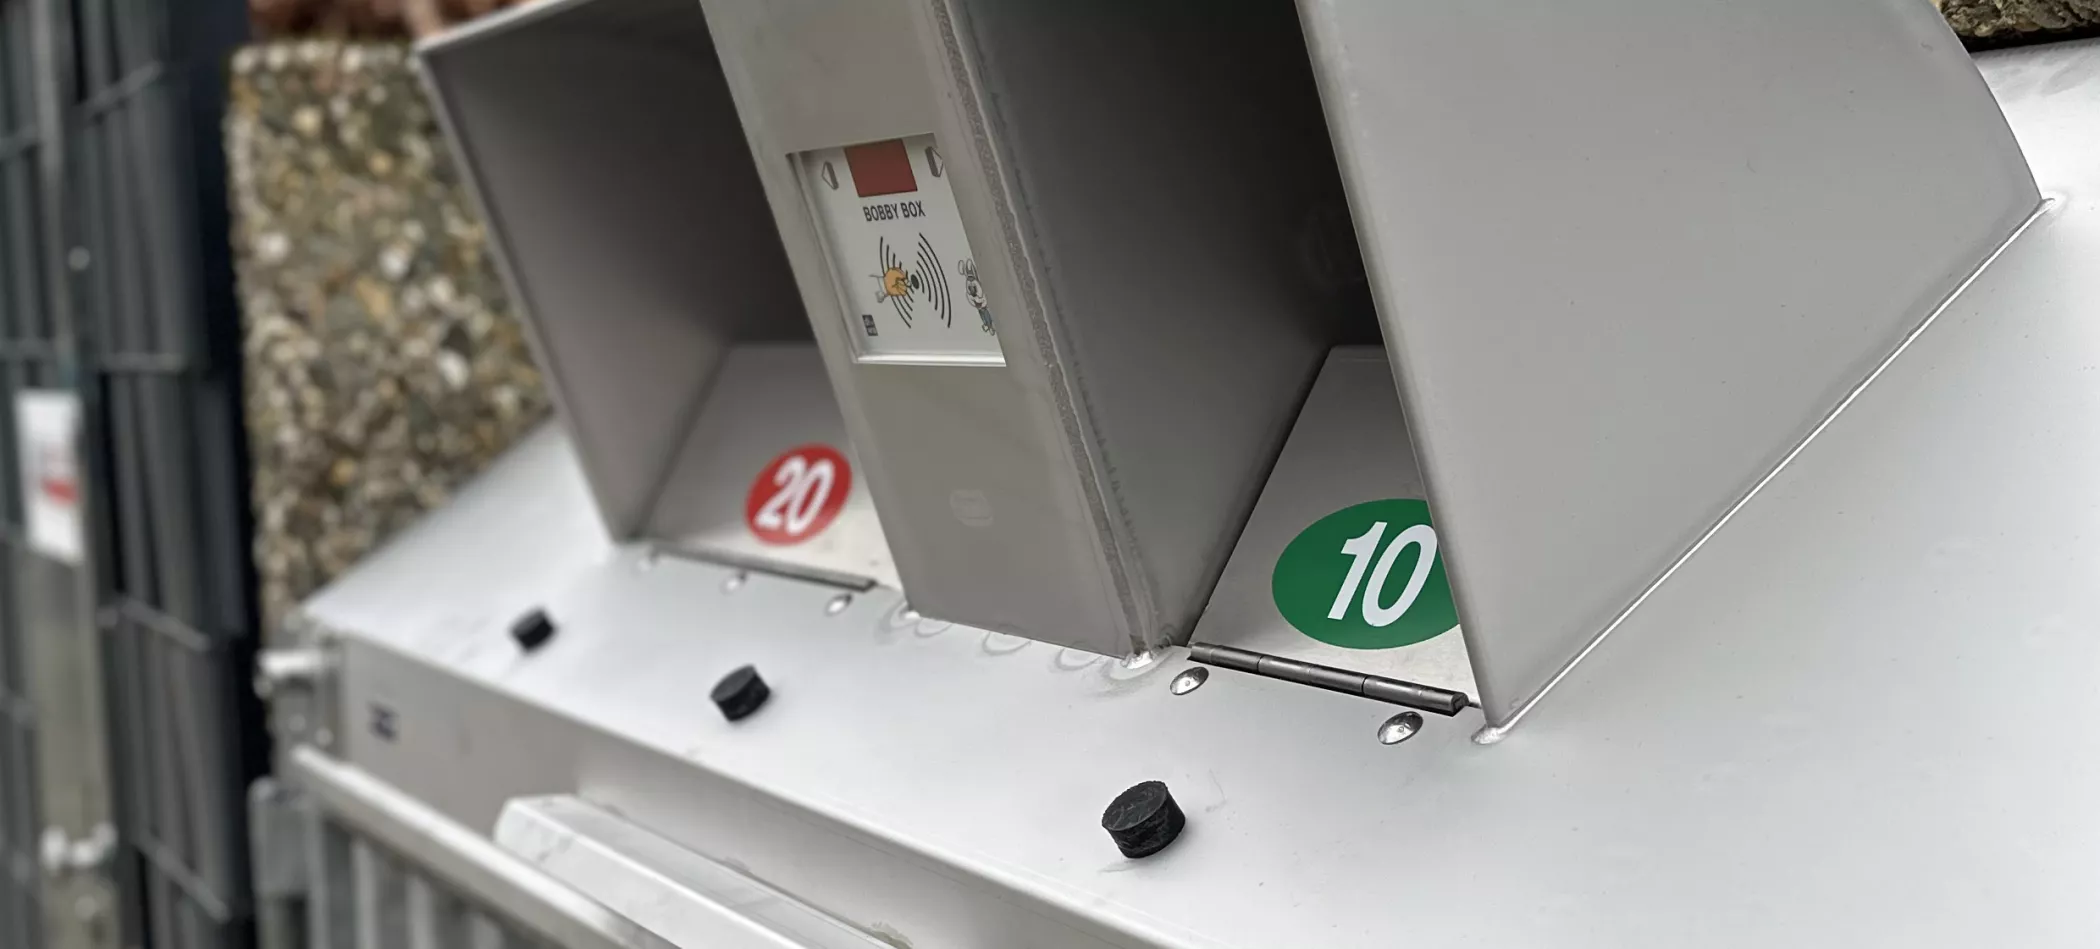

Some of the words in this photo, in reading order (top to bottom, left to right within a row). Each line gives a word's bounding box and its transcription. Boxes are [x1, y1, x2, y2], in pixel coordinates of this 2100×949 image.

[863, 204, 898, 221] BOBBY
[900, 201, 926, 218] BOX
[755, 455, 835, 535] 20
[1327, 521, 1438, 627] 10
